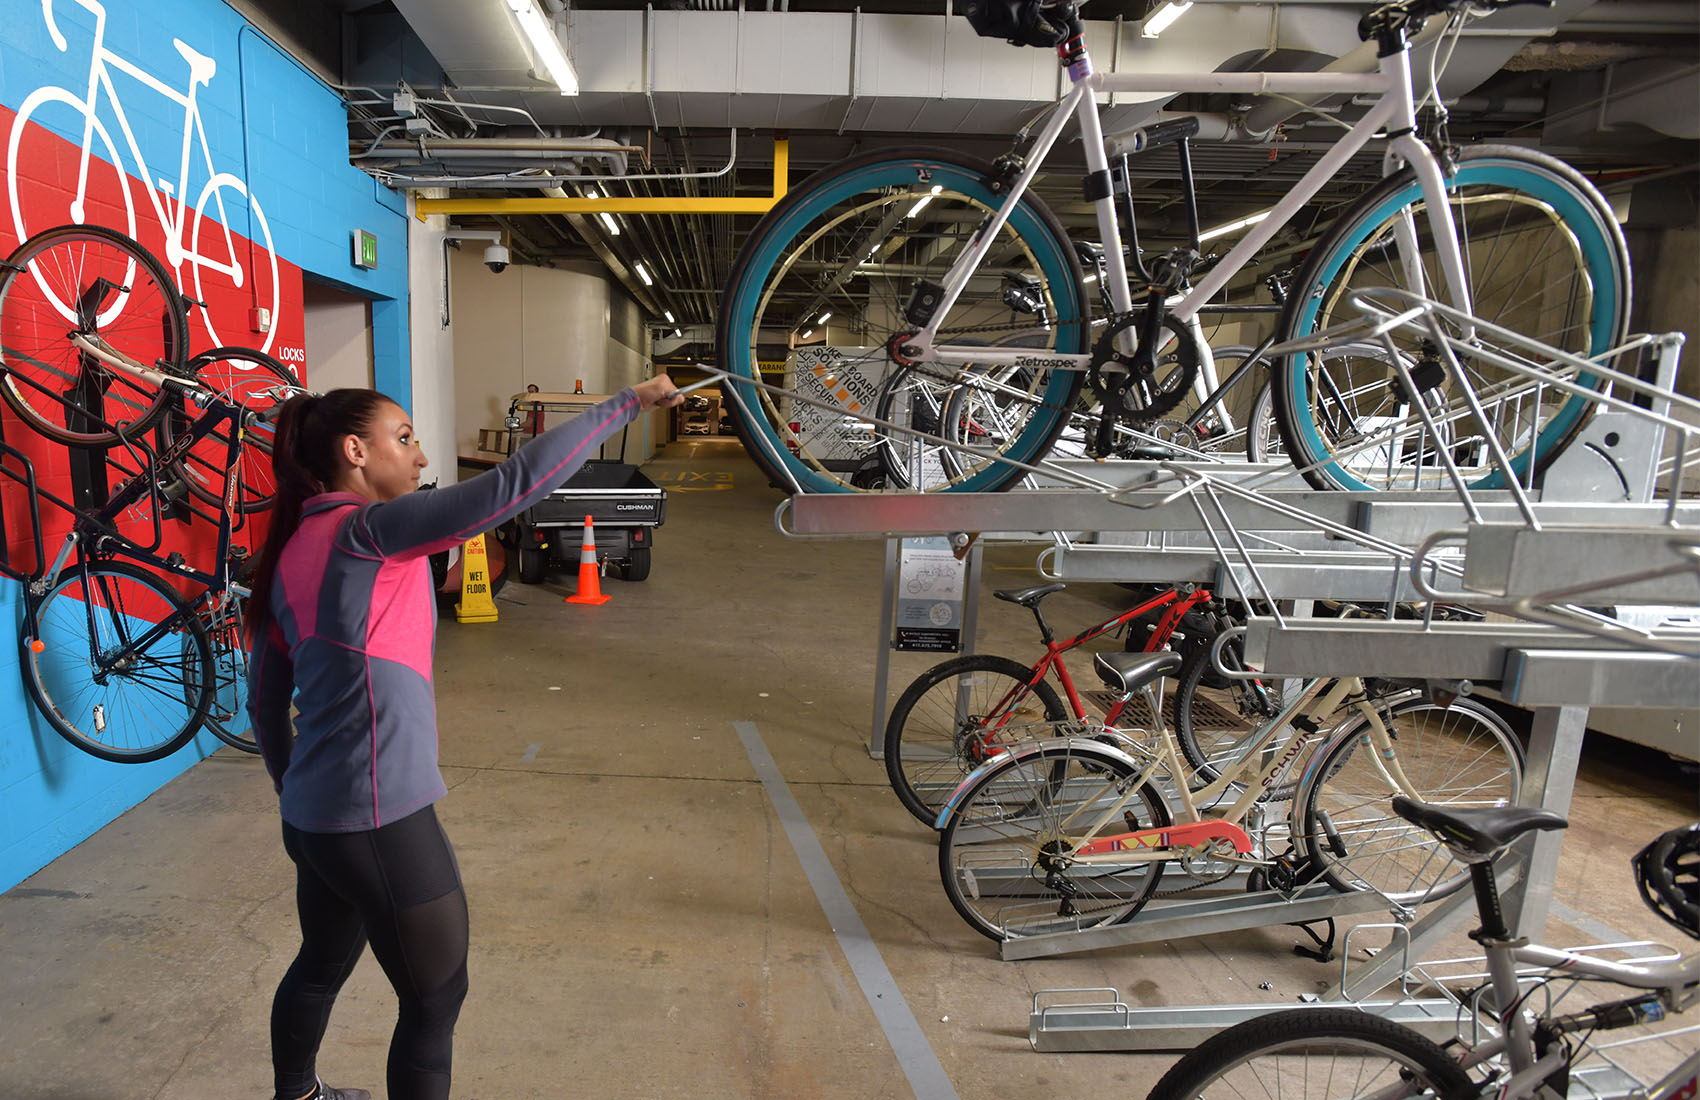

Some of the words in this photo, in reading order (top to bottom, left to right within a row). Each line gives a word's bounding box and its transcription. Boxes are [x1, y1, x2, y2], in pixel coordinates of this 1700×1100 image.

[361, 234, 376, 265] EXIT
[279, 346, 304, 362] LOCKS
[1016, 356, 1078, 368] Retrospec
[469, 571, 483, 581] WET
[466, 583, 487, 594] FLOOR
